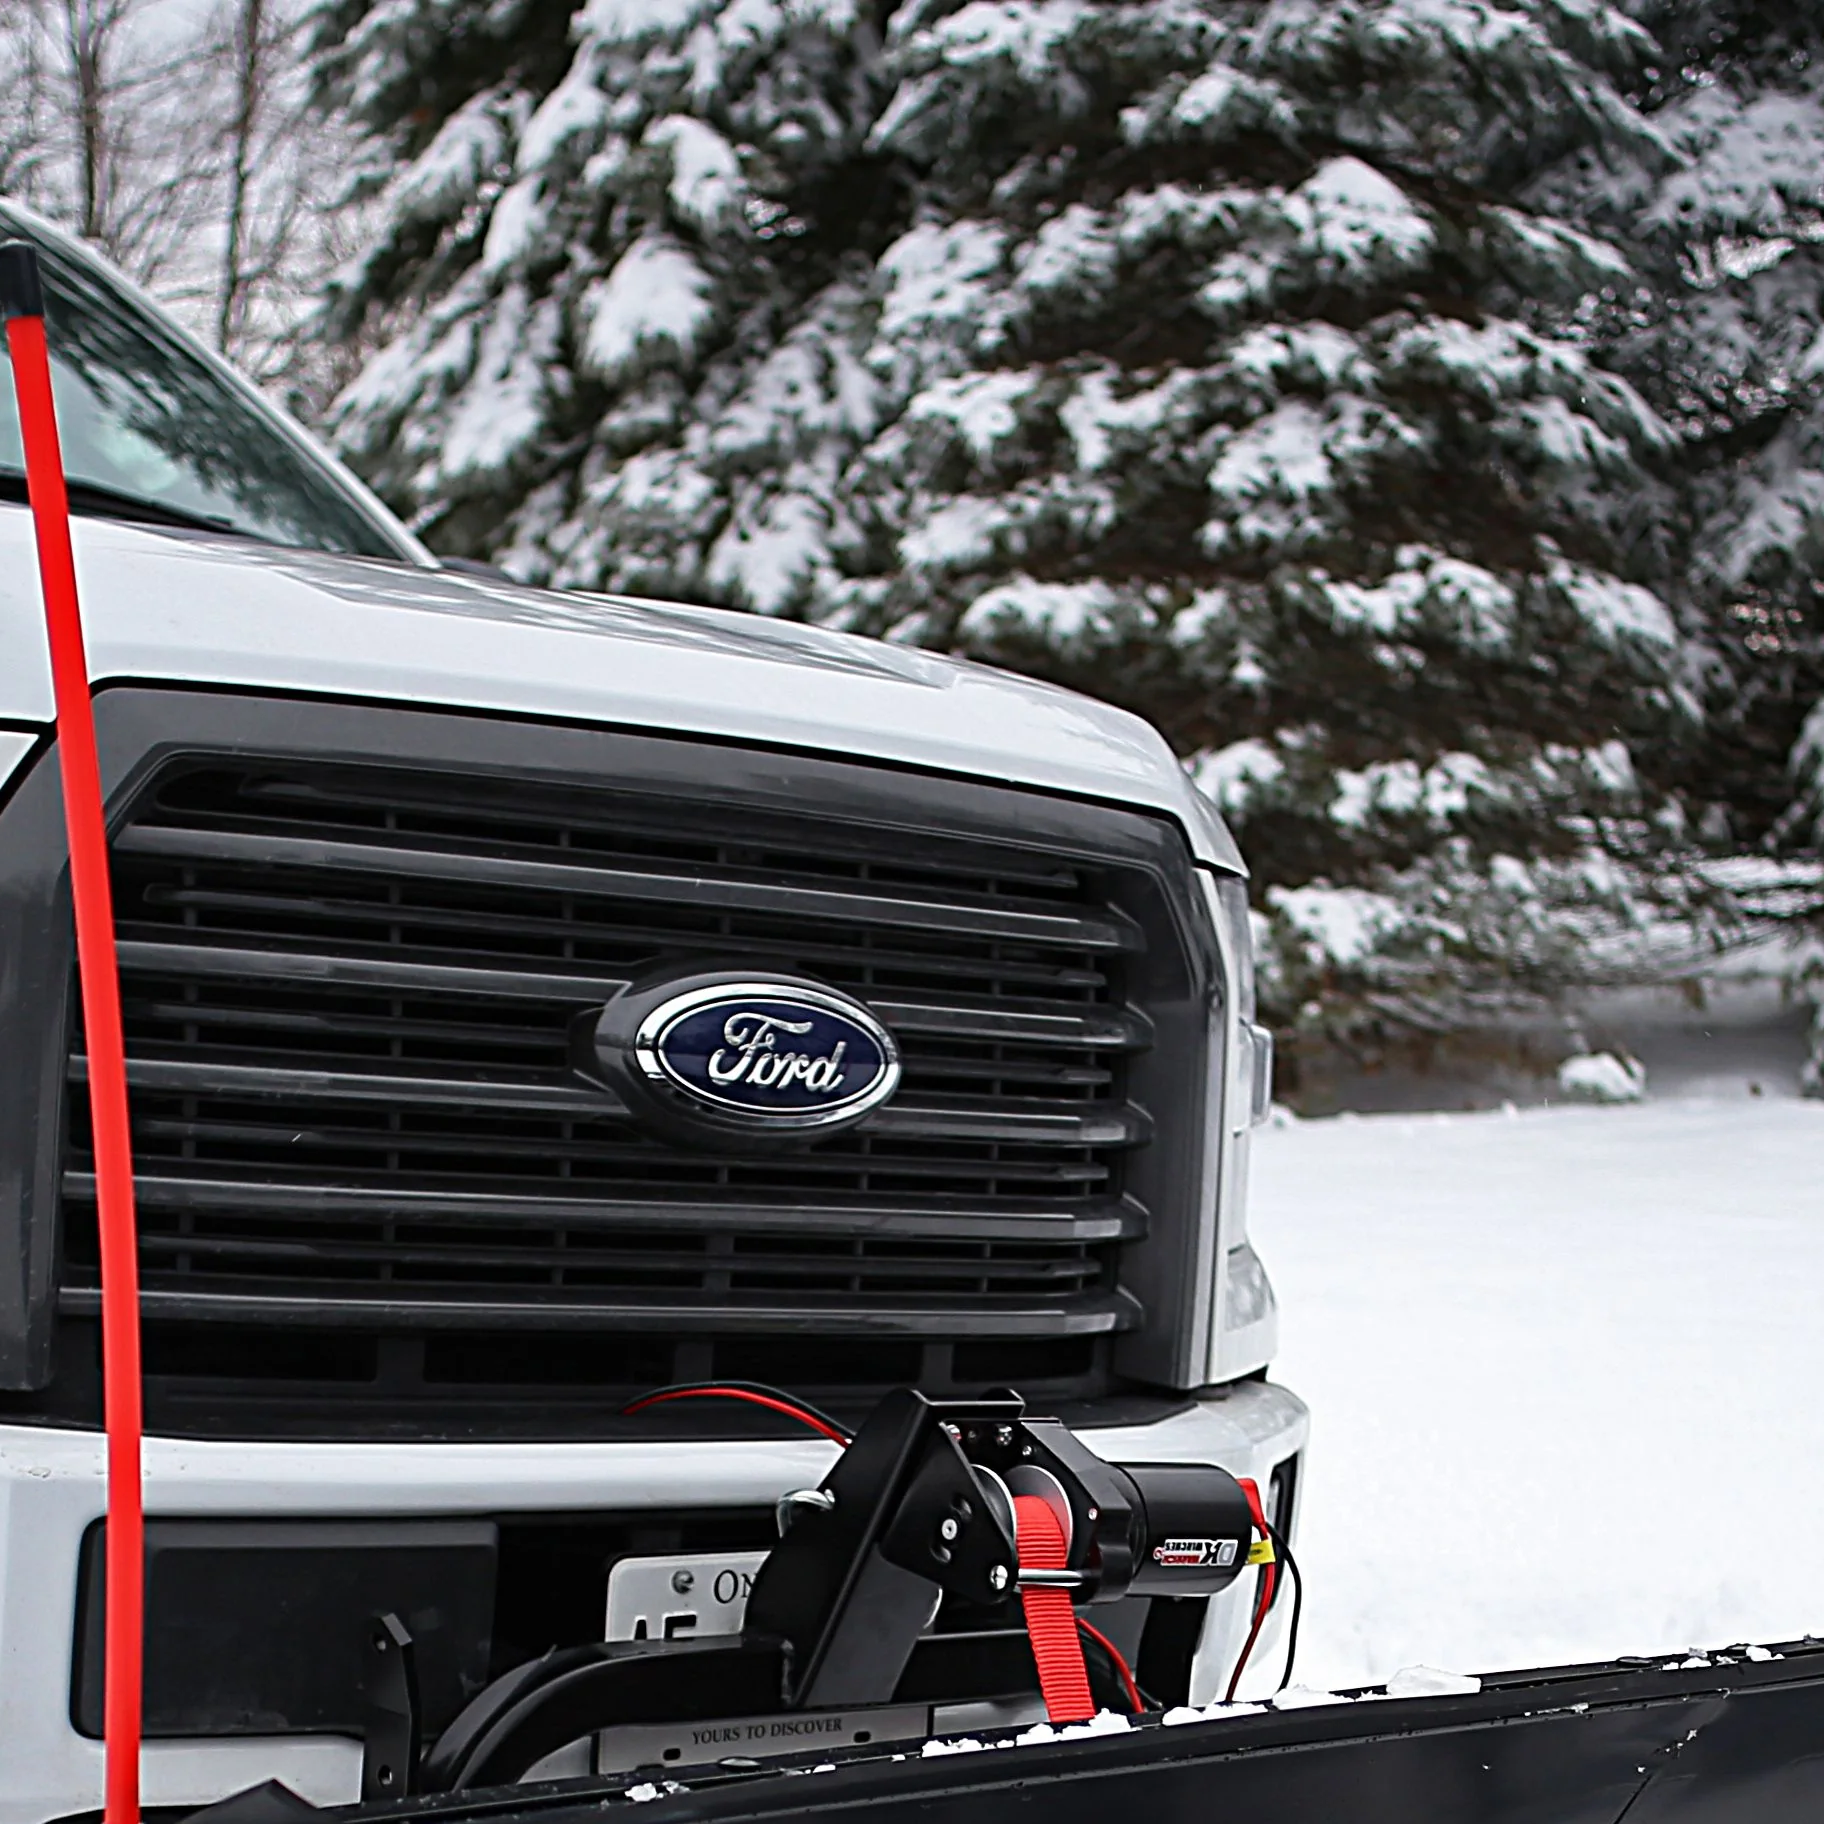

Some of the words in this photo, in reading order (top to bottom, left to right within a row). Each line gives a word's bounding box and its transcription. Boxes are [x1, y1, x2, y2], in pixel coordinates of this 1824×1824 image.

[707, 1011, 847, 1092] Ford
[692, 1727, 741, 1745] YOURS
[747, 1725, 766, 1740] TO
[770, 1718, 843, 1738] DISCOVER
